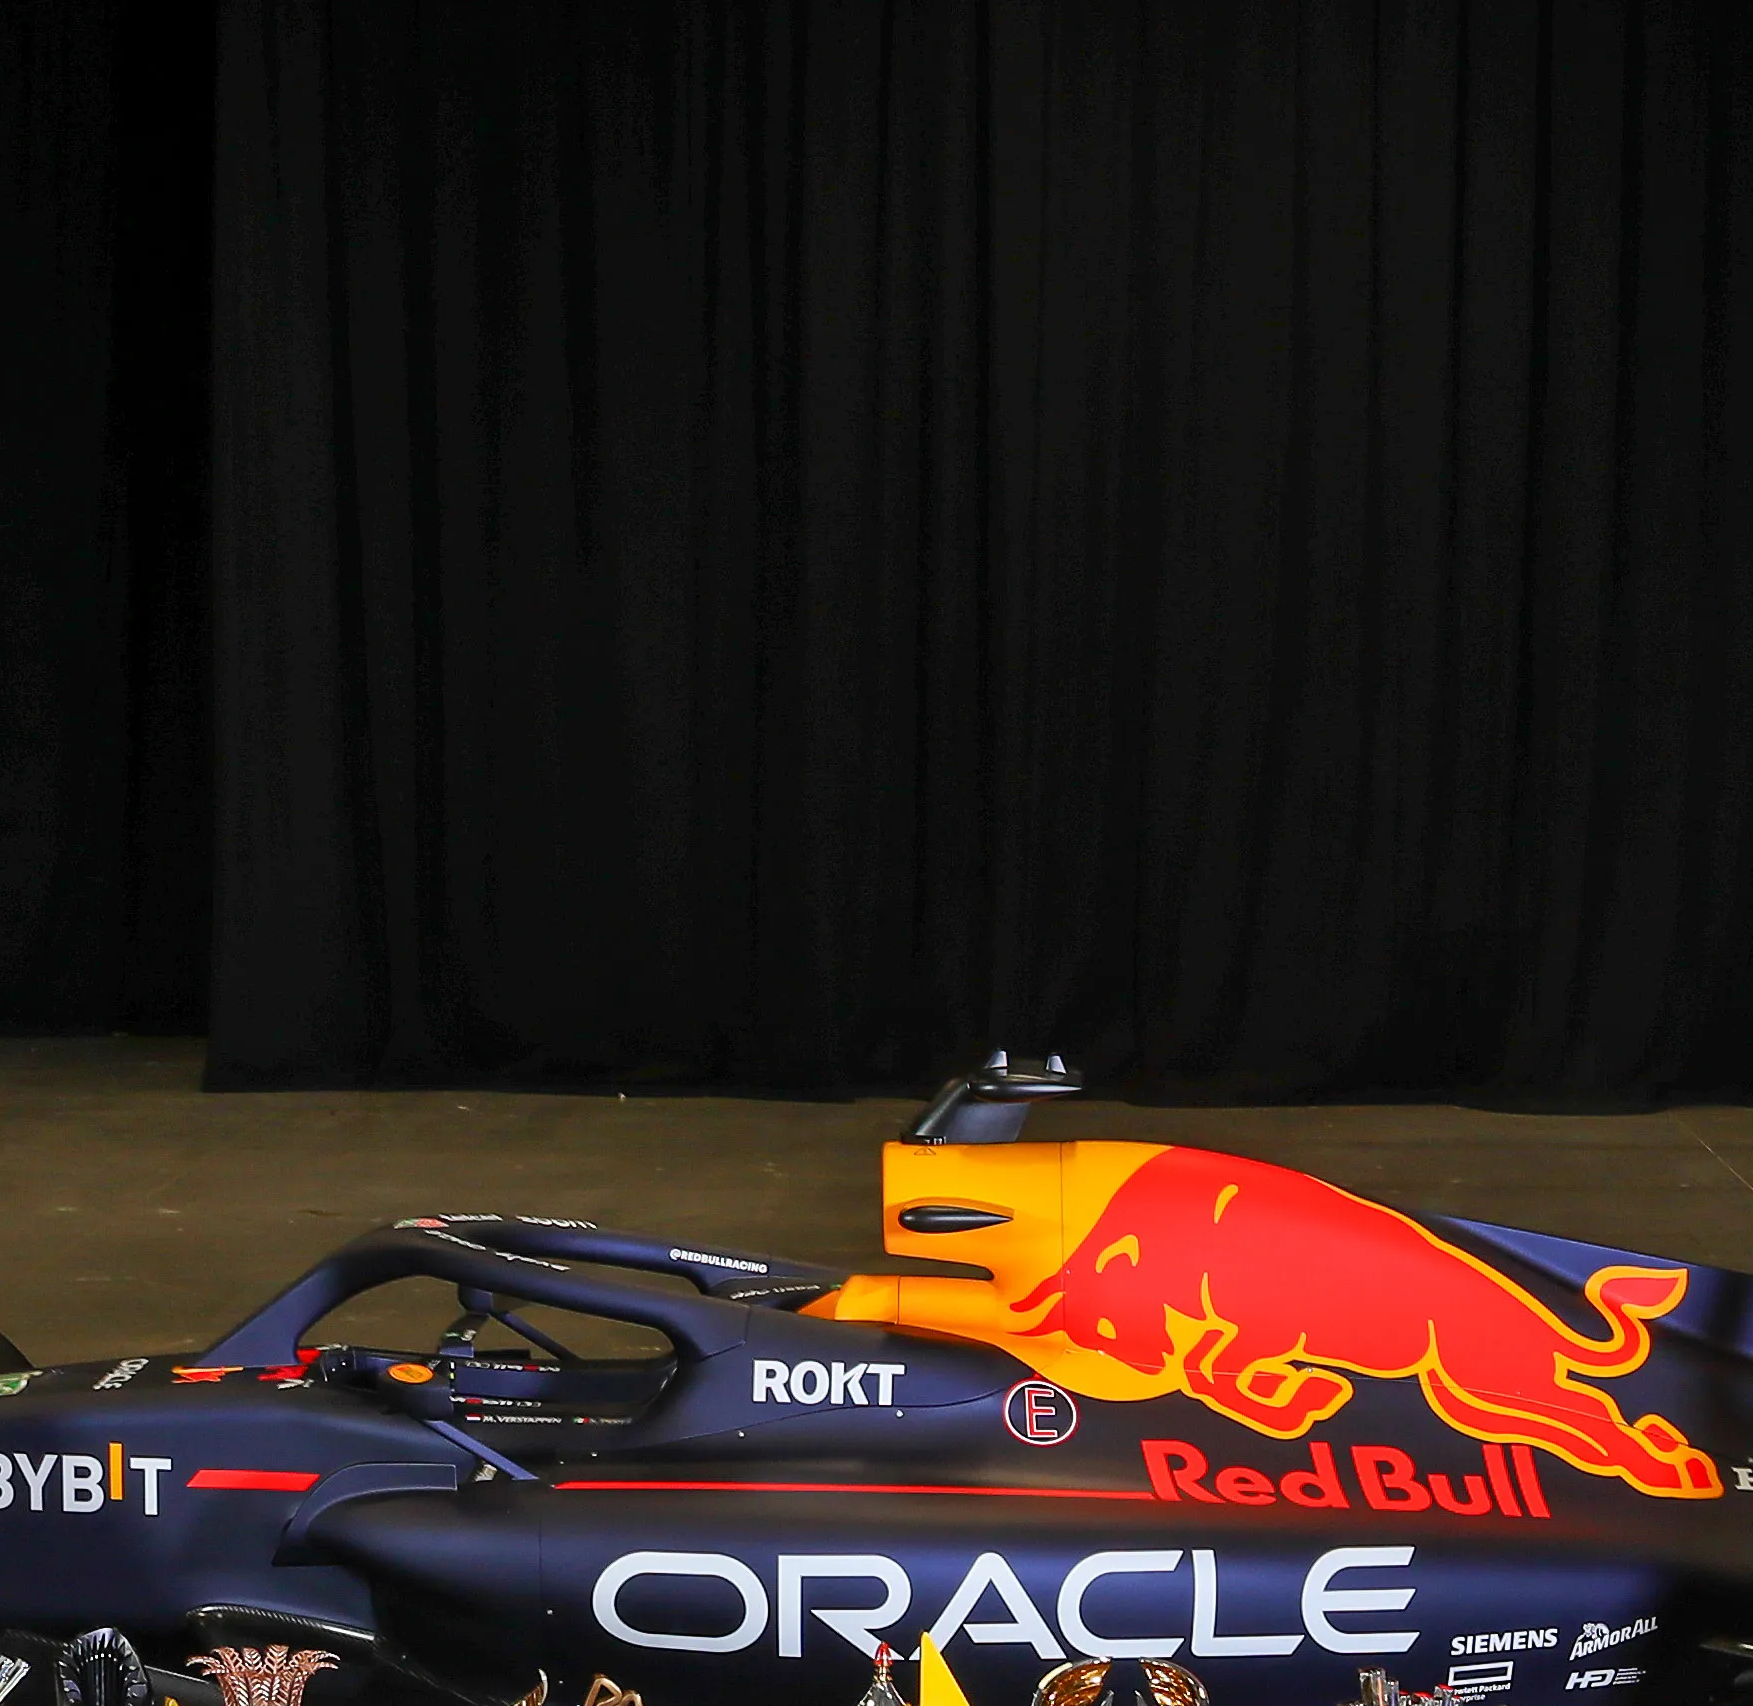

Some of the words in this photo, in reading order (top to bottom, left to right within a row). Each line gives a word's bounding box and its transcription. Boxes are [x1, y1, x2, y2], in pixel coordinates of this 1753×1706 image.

[669, 1247, 769, 1275] @REDBULLRACING
[751, 1358, 906, 1407] ROKT
[1140, 1439, 1350, 1509] Red
[1349, 1442, 1552, 1519] Bull
[591, 1546, 1421, 1661] ORACLE
[1449, 1627, 1559, 1656] SIEMENS
[1478, 1682, 1512, 1694] Packard
